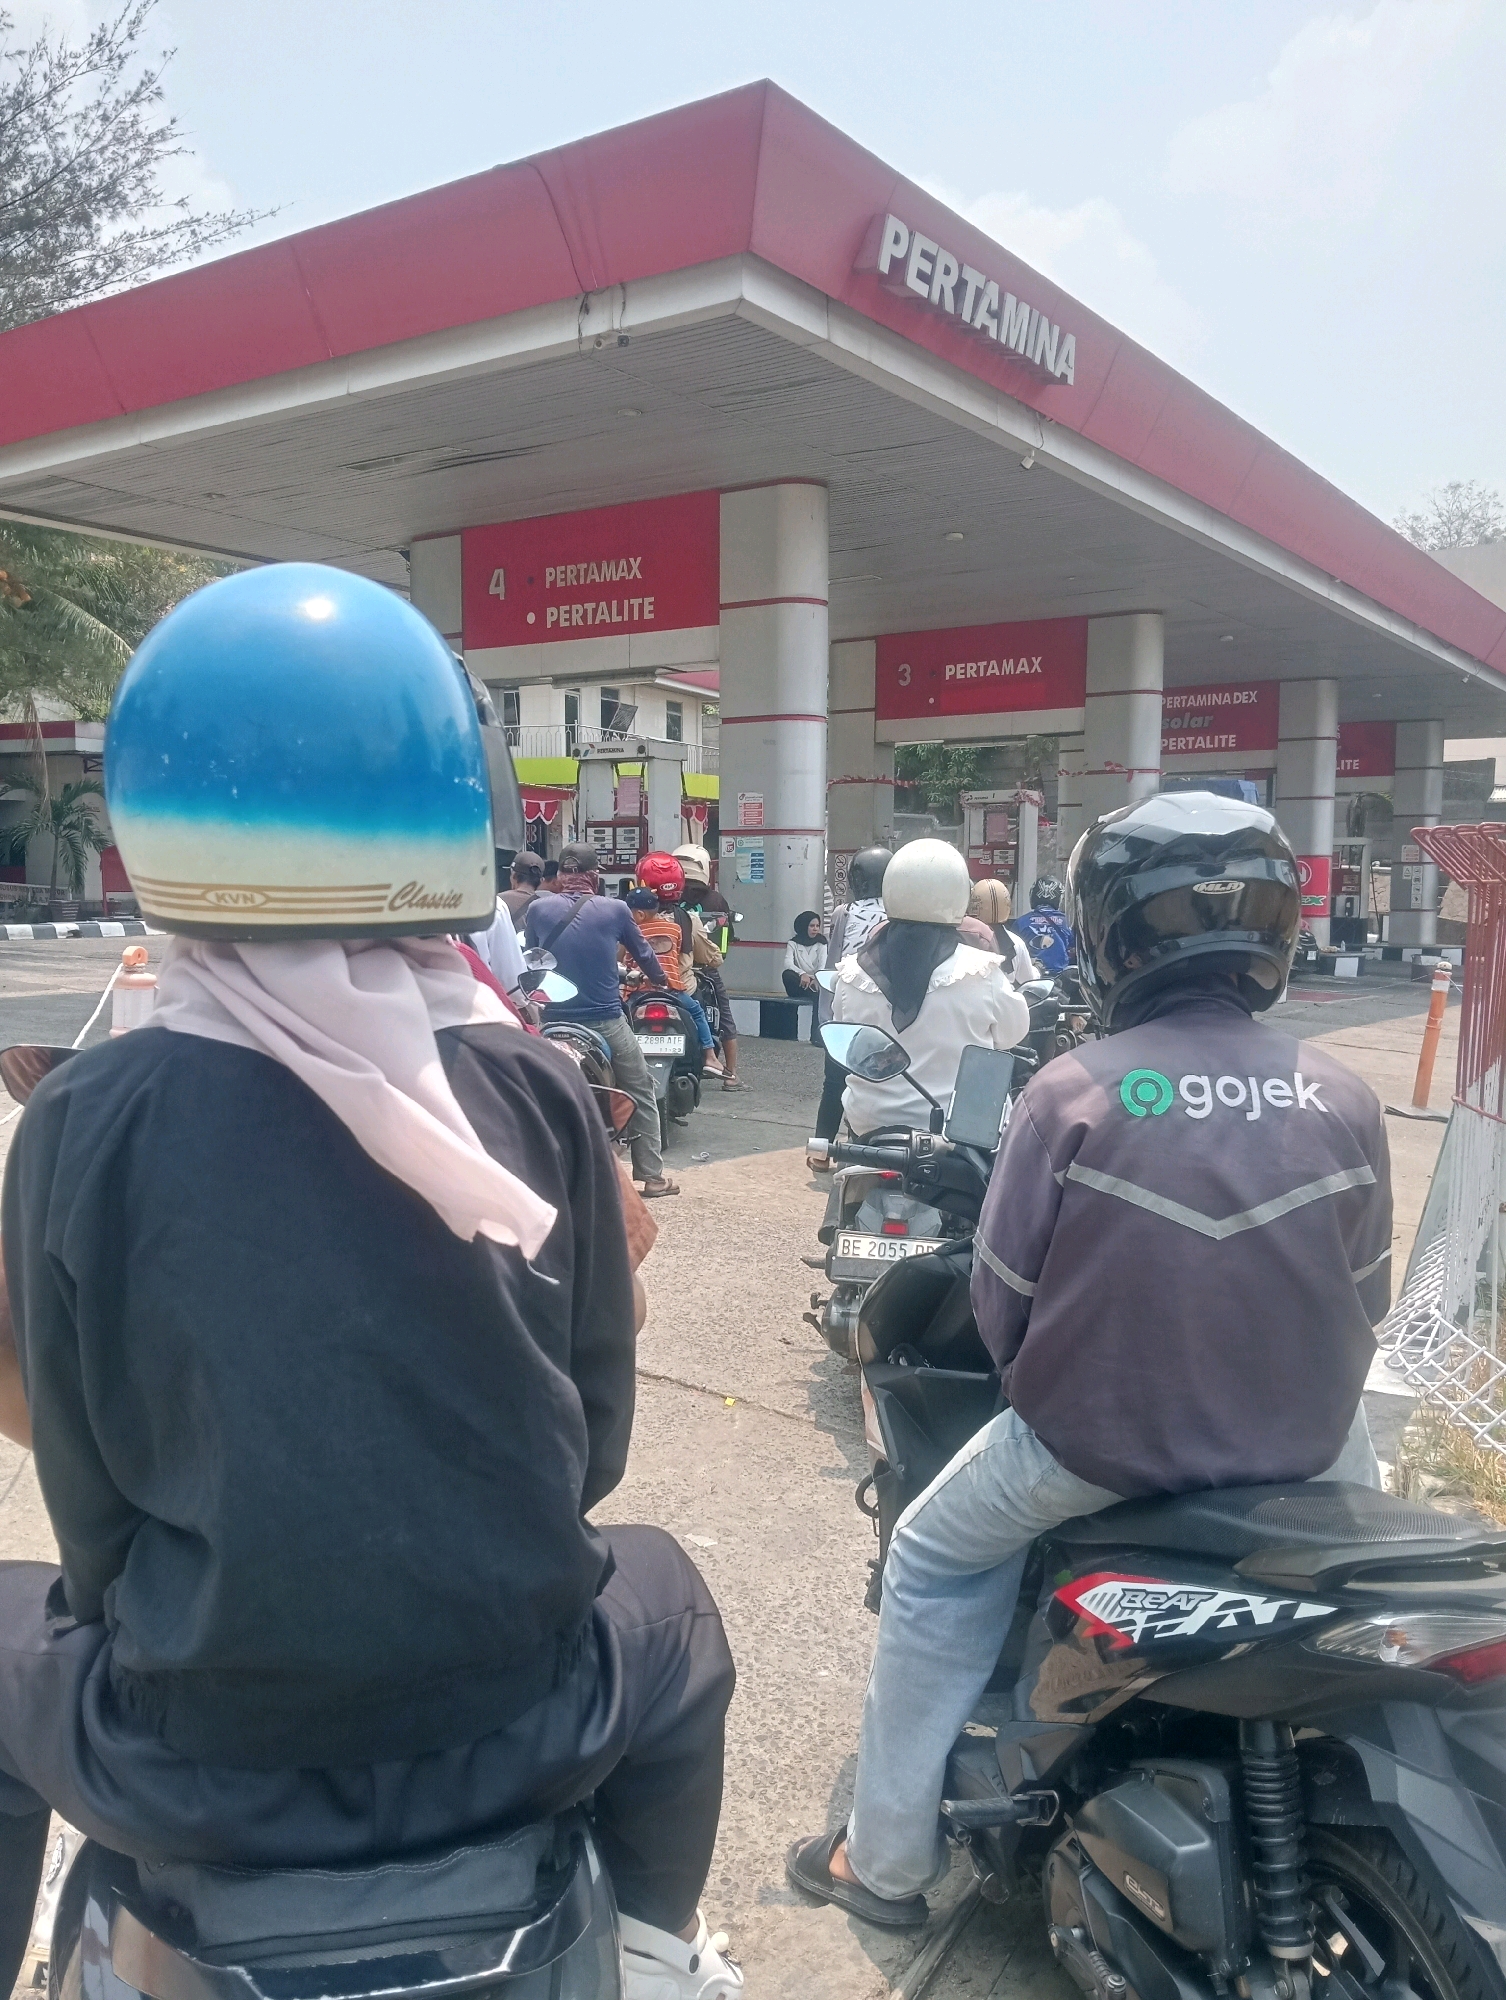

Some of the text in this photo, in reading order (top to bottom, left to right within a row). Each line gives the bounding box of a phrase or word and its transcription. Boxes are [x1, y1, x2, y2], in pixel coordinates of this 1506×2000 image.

[877, 213, 1076, 386] PERTAMINA
[488, 557, 642, 600] 4 PERTAMAX
[546, 597, 655, 629] PERTALITE
[898, 657, 1042, 686] 3 PERTAMAX
[1233, 690, 1258, 704] DEX
[215, 892, 256, 905] KVN
[1178, 1071, 1329, 1121] gojek
[842, 1238, 861, 1256] BE
[868, 1240, 908, 1258] 2055
